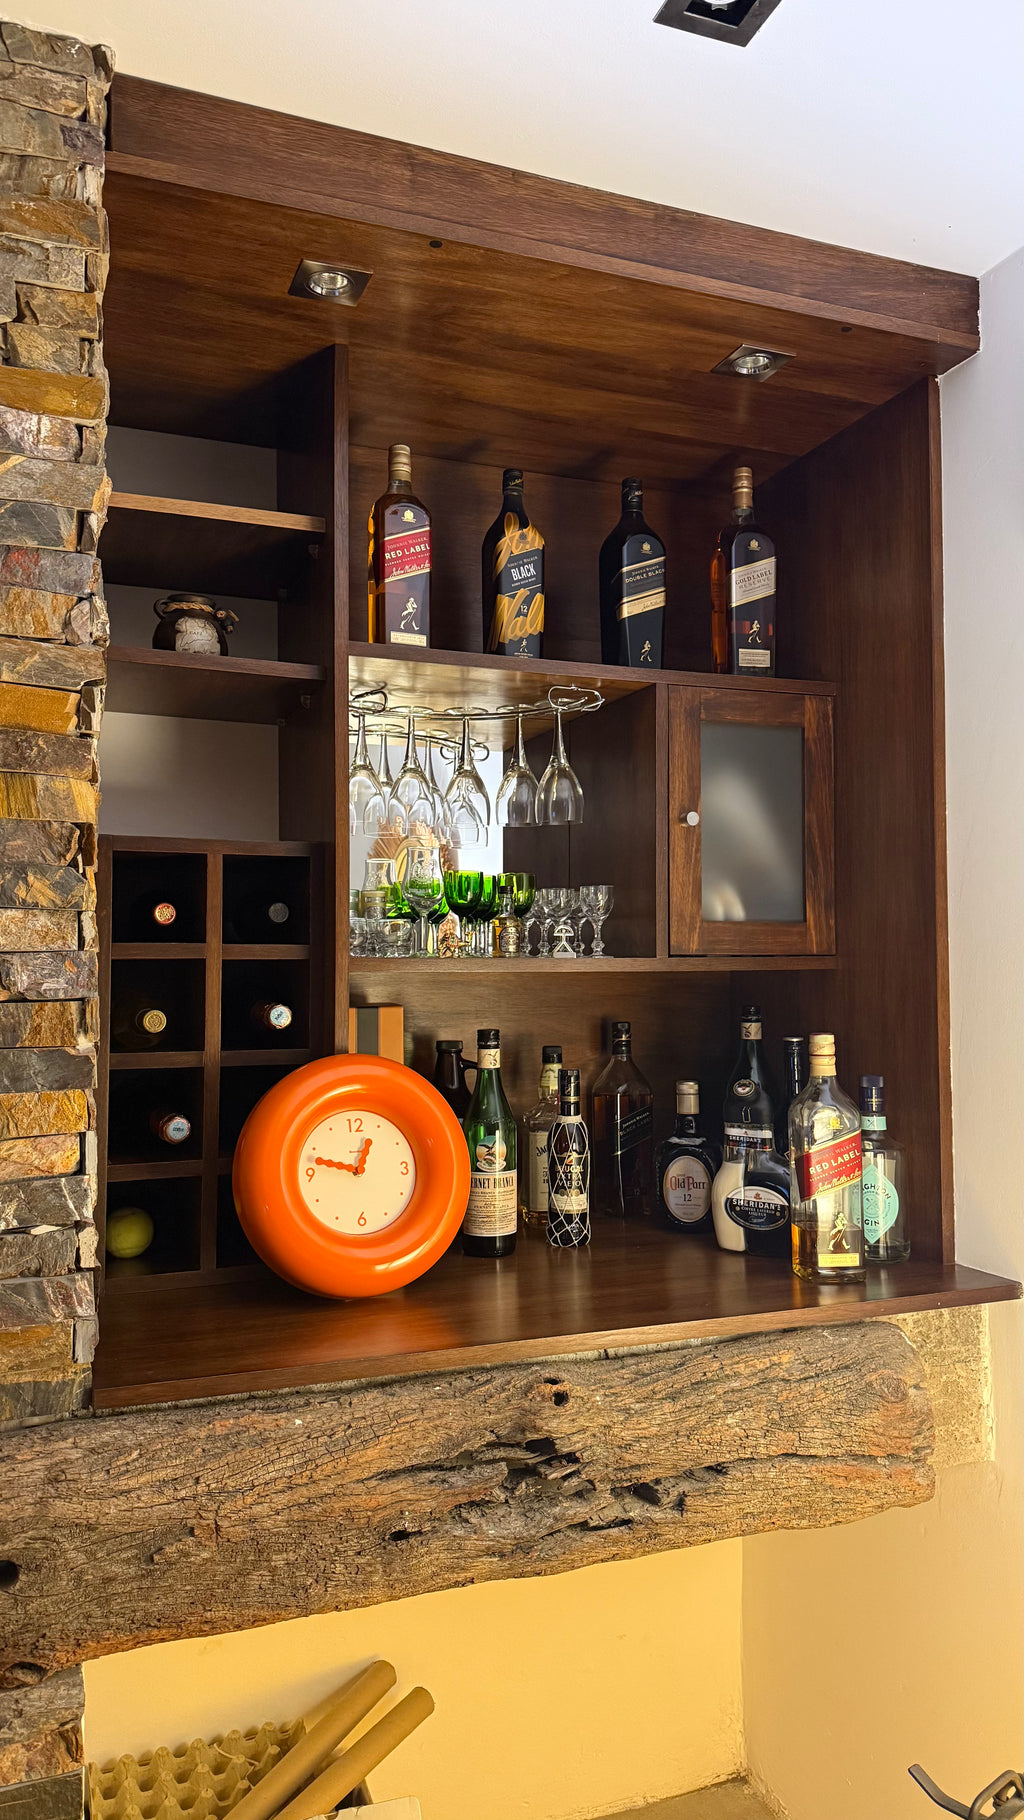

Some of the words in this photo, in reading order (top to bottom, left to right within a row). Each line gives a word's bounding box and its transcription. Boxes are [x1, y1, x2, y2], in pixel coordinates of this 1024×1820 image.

[385, 550, 403, 560] RED
[404, 543, 430, 555] LABEL
[511, 563, 537, 581] BLACK
[626, 574, 648, 584] DOUBLE
[736, 576, 752, 585] GOLD
[752, 569, 772, 580] LABEL
[739, 576, 771, 590] RESERVE
[520, 605, 528, 613] 12
[346, 1118, 364, 1133] 12
[400, 1161, 410, 1176] 3
[555, 1165, 585, 1173] BRUGAL
[809, 1162, 830, 1175] RED
[831, 1149, 861, 1167] LABEL
[305, 1167, 316, 1182] 9
[471, 1177, 490, 1189] ERNET
[669, 1175, 686, 1191] Old
[685, 1175, 708, 1191] Parr
[683, 1193, 692, 1202] 12
[732, 1198, 781, 1211] SHERIDAN'S
[357, 1211, 367, 1227] 6
